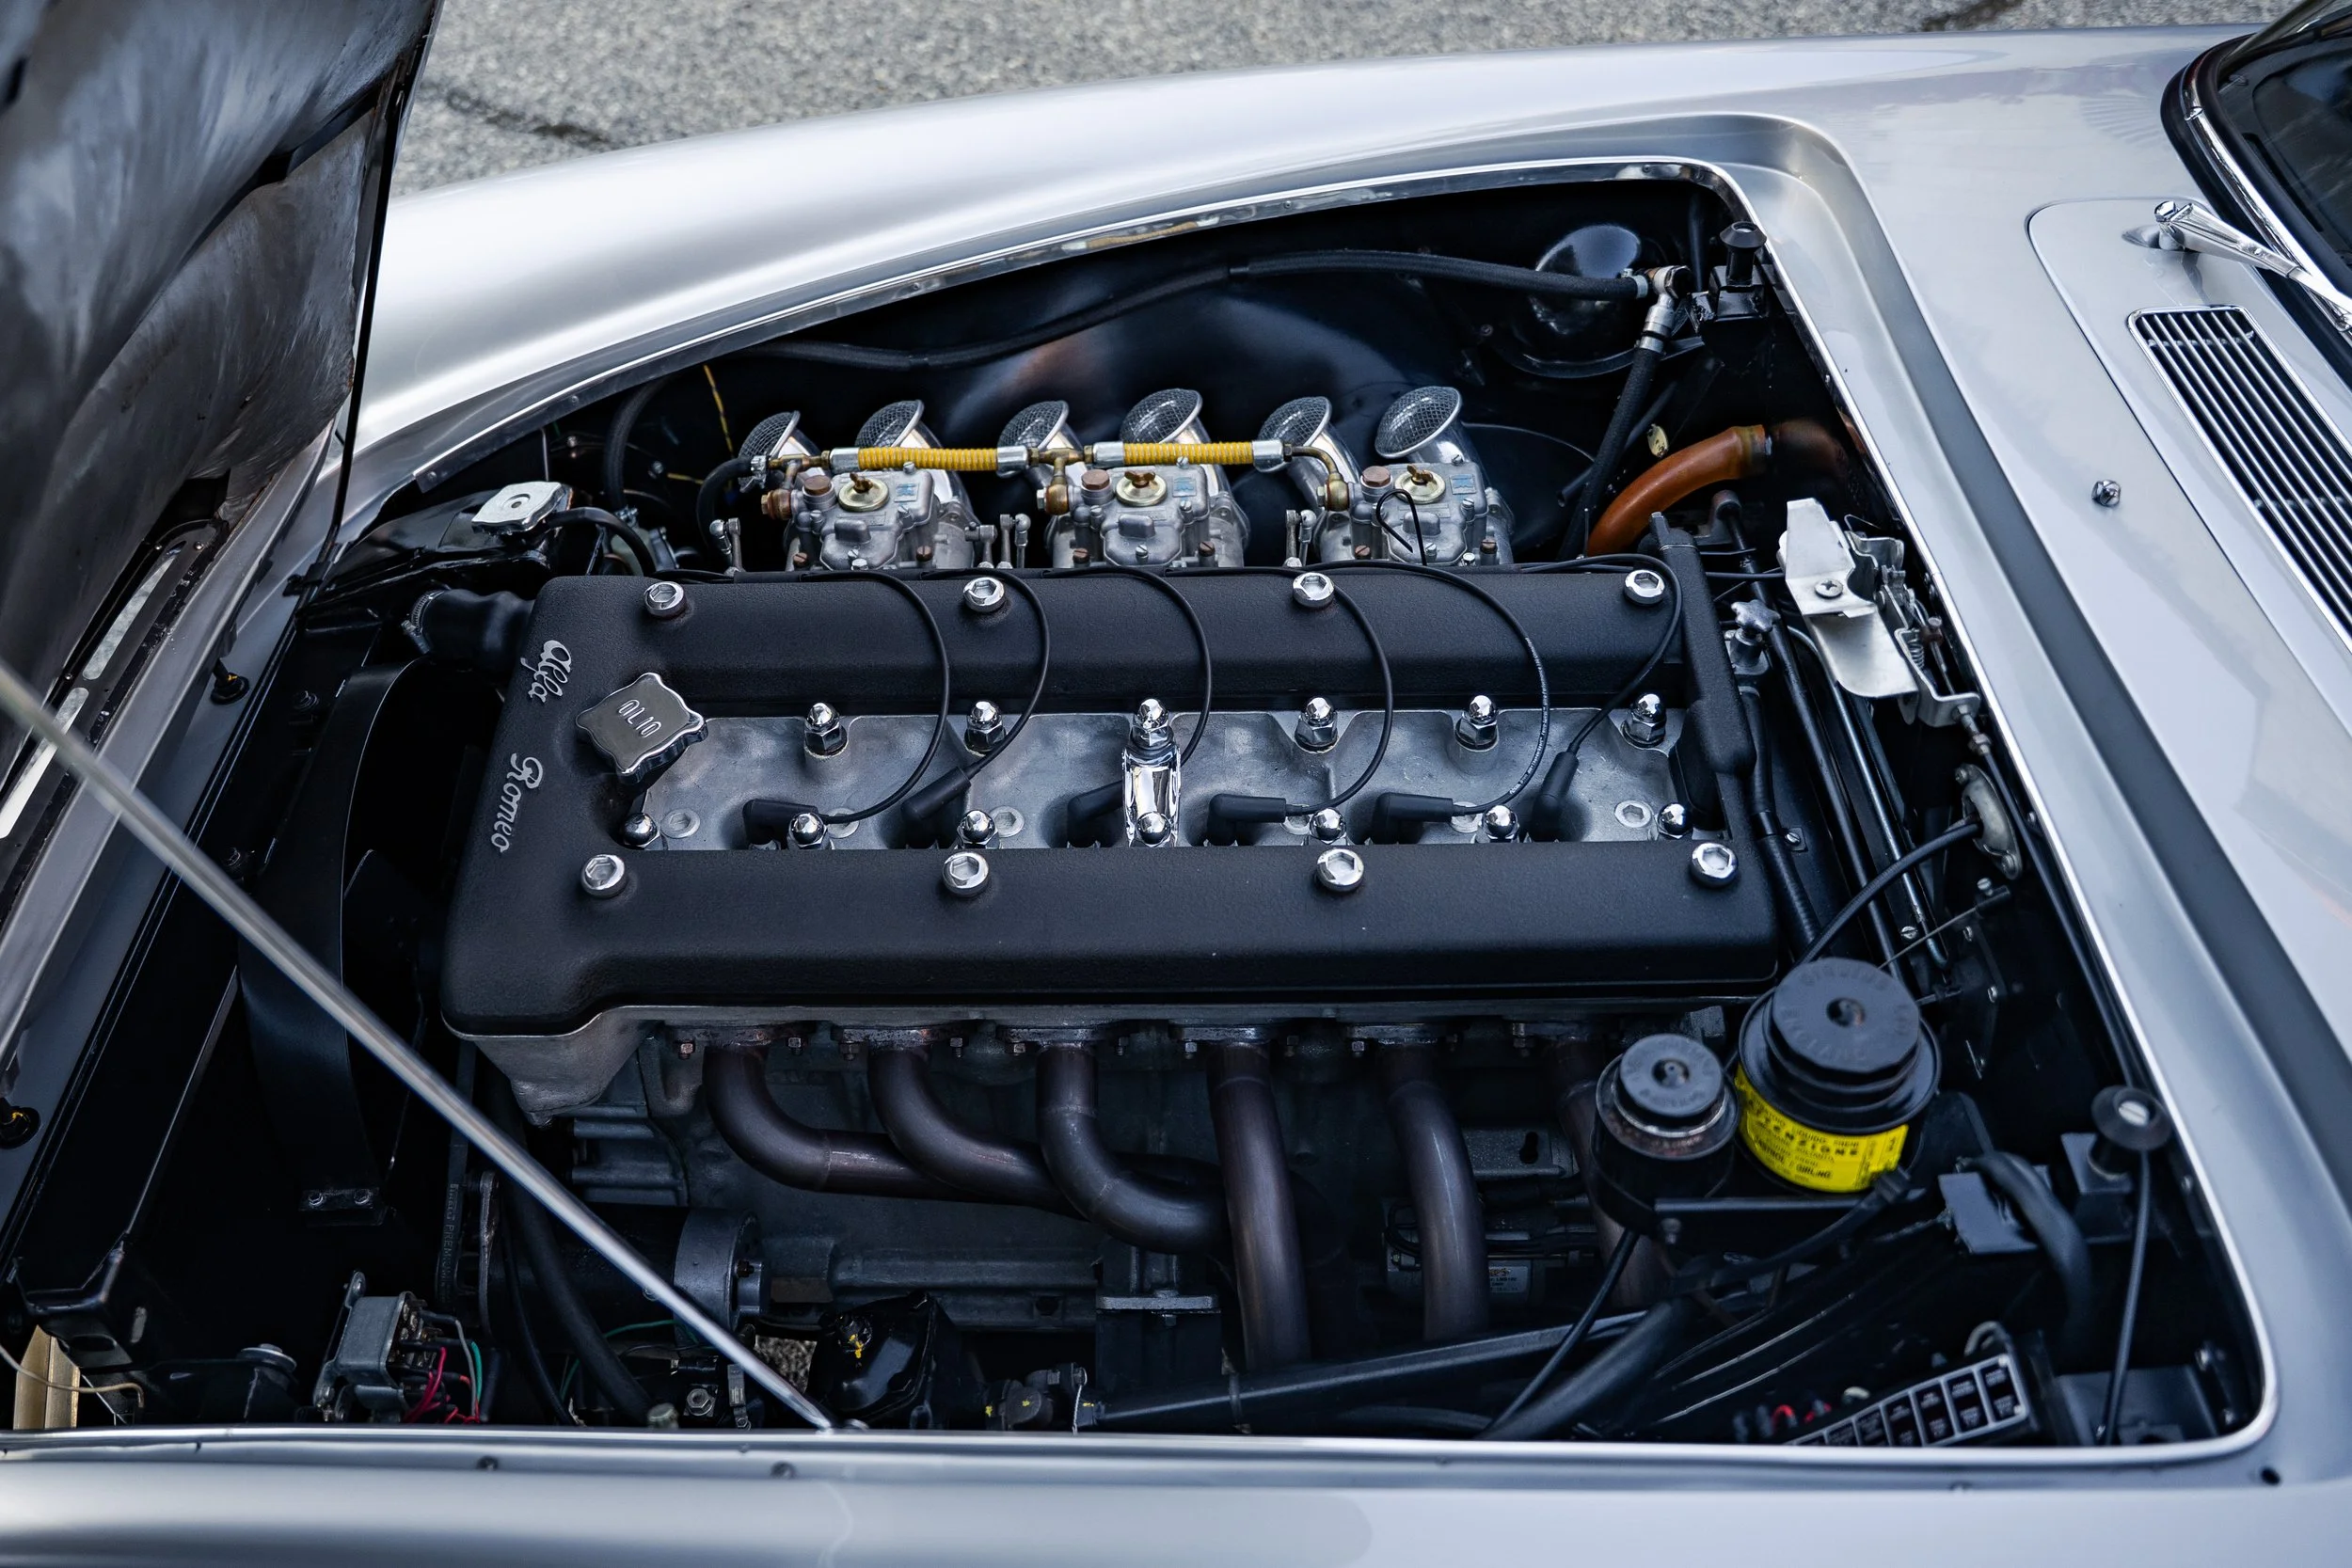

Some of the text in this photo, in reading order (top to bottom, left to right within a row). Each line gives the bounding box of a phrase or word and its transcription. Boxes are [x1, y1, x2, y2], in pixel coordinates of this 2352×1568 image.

[491, 640, 572, 853] Alfa Romeo
[617, 699, 662, 738] OLIO
